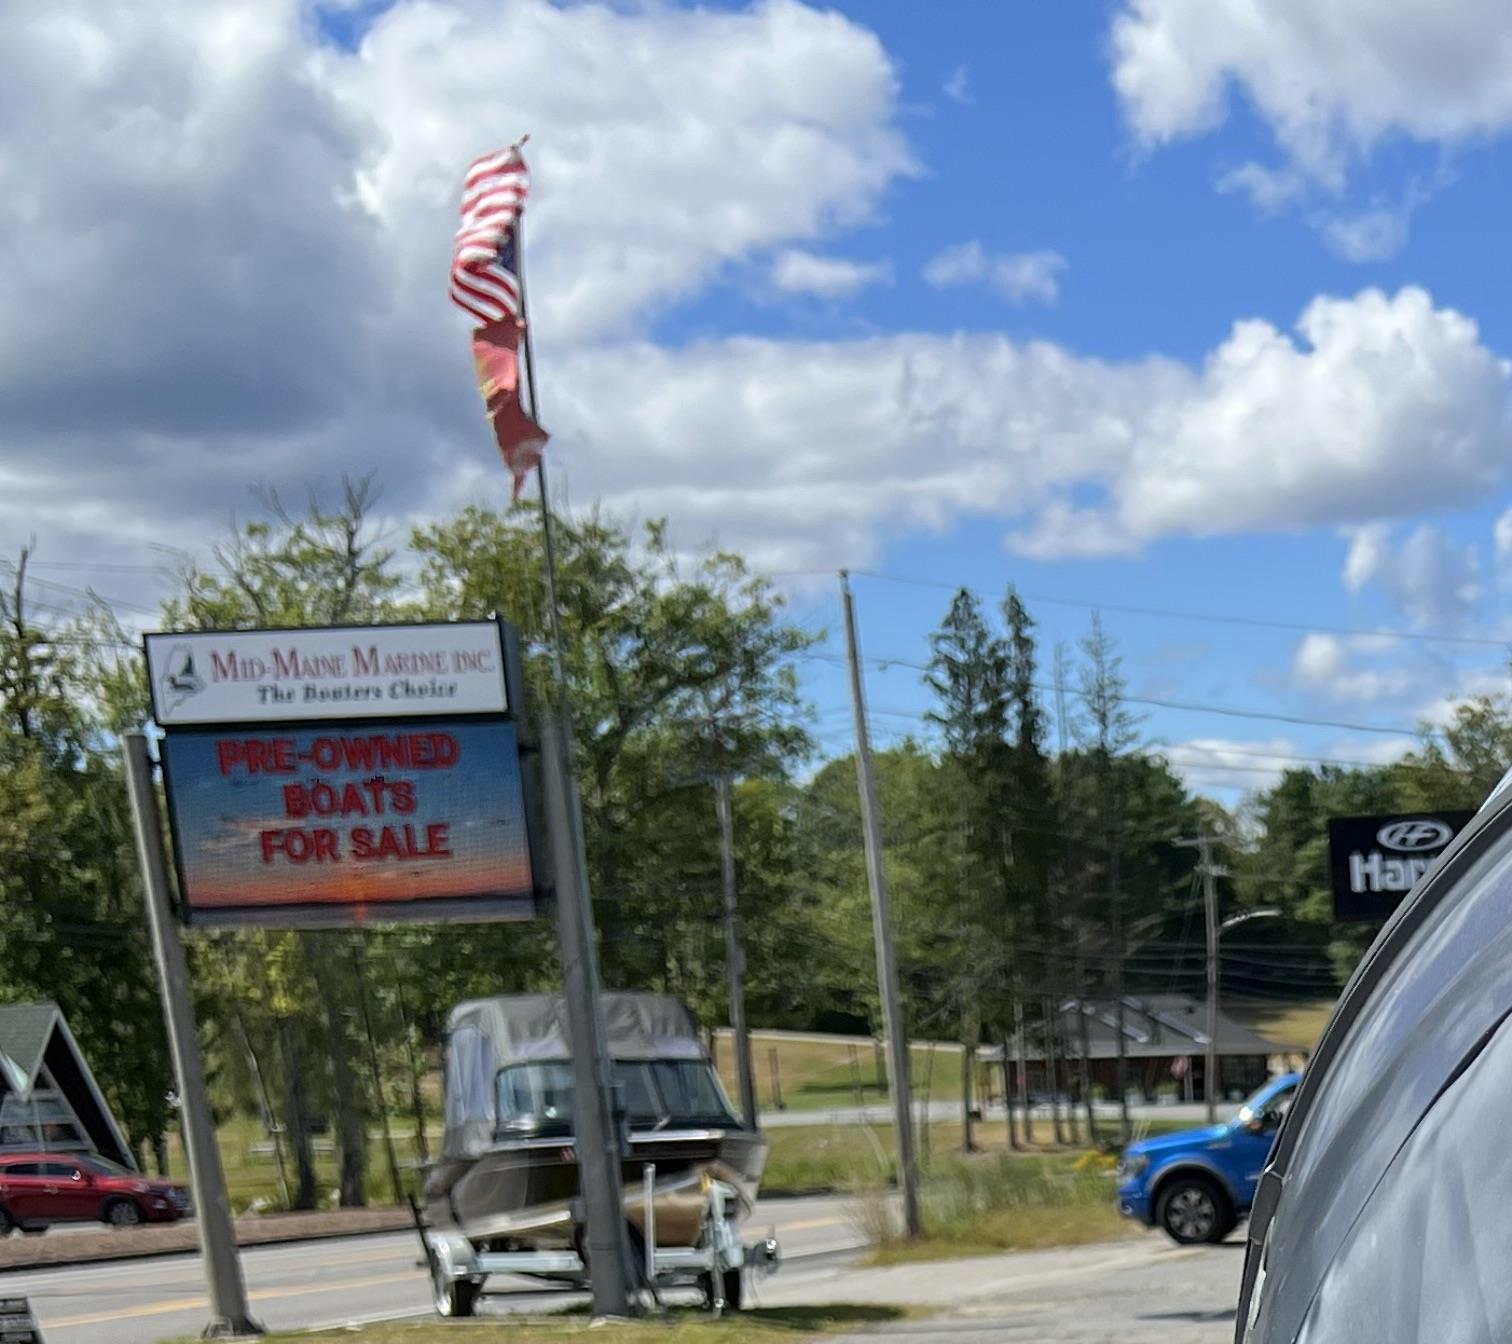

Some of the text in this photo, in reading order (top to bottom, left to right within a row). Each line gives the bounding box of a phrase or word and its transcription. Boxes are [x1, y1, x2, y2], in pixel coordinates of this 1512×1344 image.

[256, 683, 296, 705] The
[387, 677, 458, 700] Choice
[216, 731, 461, 776] PRE-OWNED
[281, 780, 417, 820] BOATS
[260, 823, 453, 865] FOR SALE
[1348, 851, 1438, 893] Har
